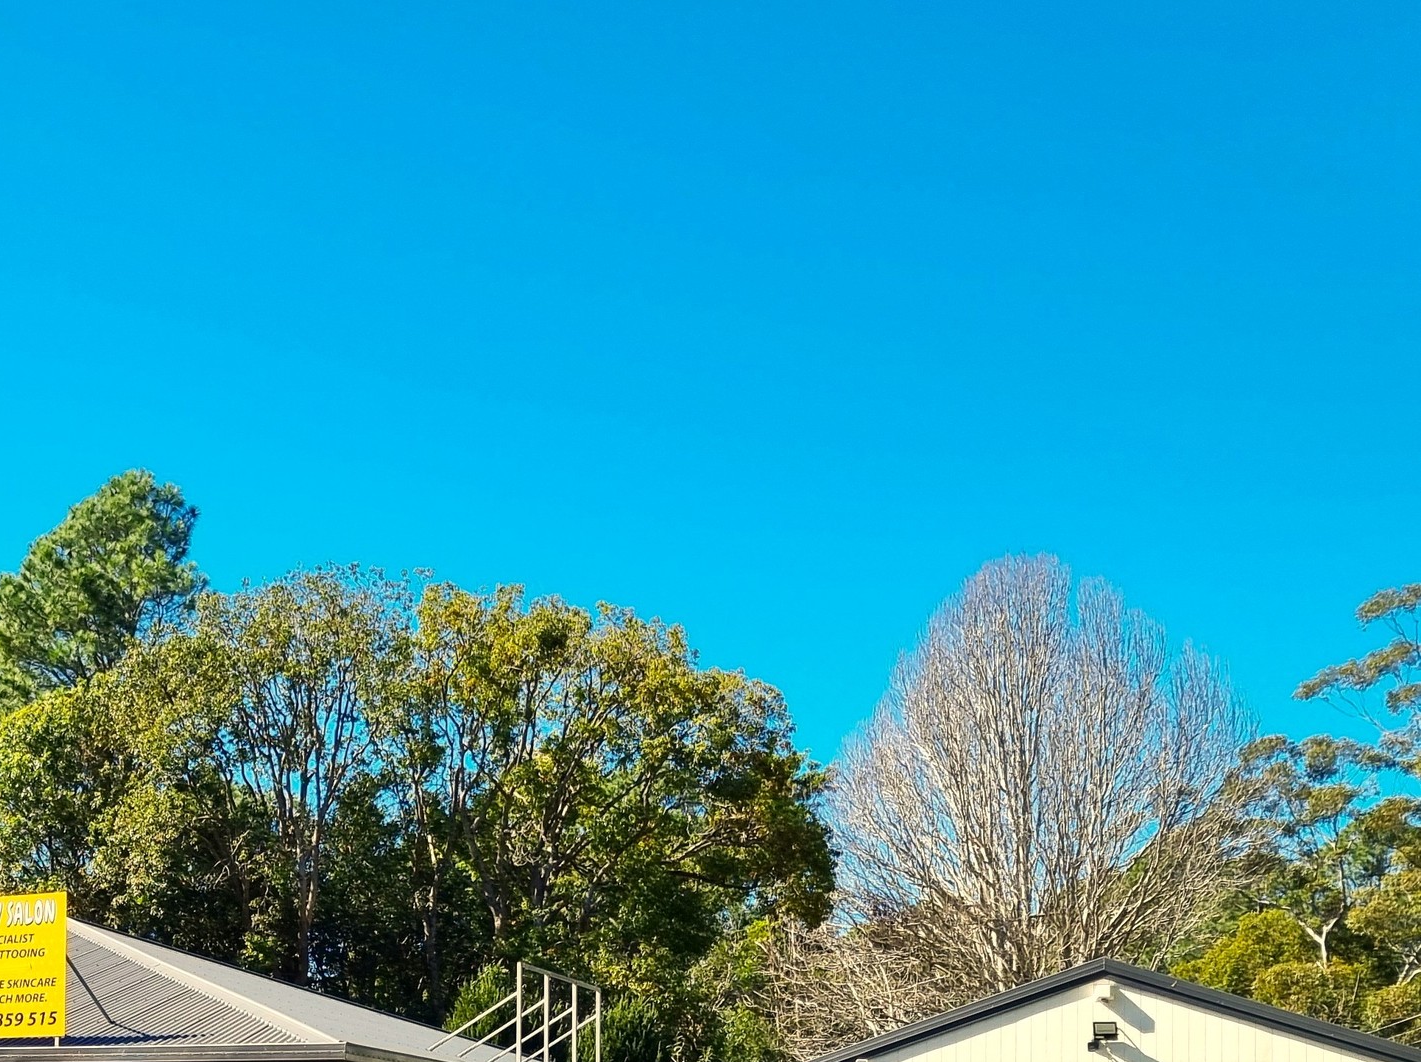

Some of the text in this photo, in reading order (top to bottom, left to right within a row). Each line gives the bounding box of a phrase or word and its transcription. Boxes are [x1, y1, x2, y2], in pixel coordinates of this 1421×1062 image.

[7, 899, 57, 927] SALON
[7, 977, 57, 989] SKINCARE
[15, 993, 47, 1003] MORE.
[27, 1011, 57, 1025] 515
